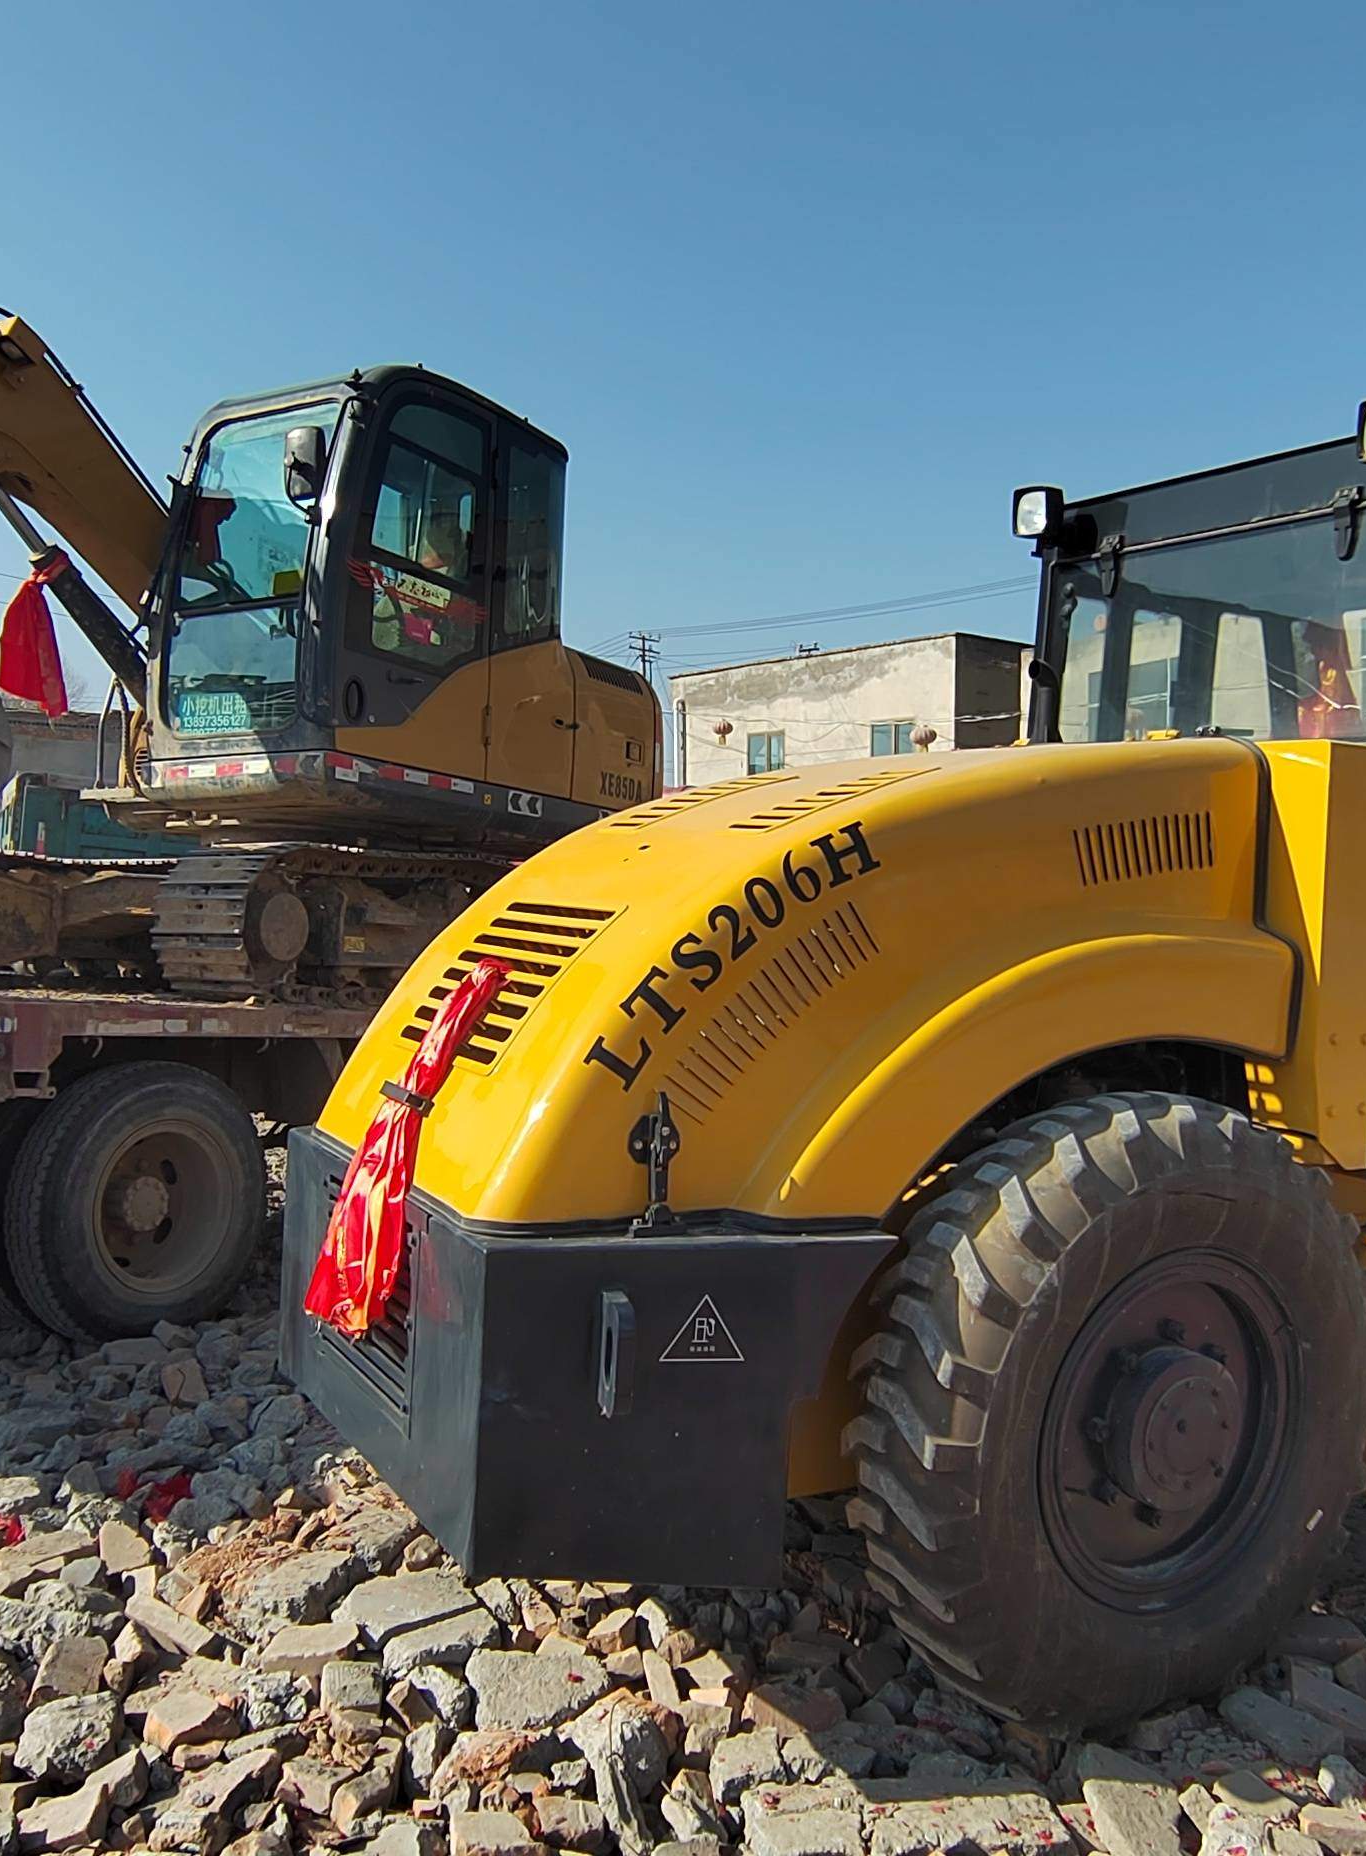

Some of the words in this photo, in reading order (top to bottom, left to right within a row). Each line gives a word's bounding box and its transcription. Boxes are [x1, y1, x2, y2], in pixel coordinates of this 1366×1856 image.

[182, 694, 247, 716] 小挖机出租
[183, 714, 247, 728] 13897356127
[599, 771, 643, 803] XE85DA
[585, 821, 881, 1092] LTS206H
